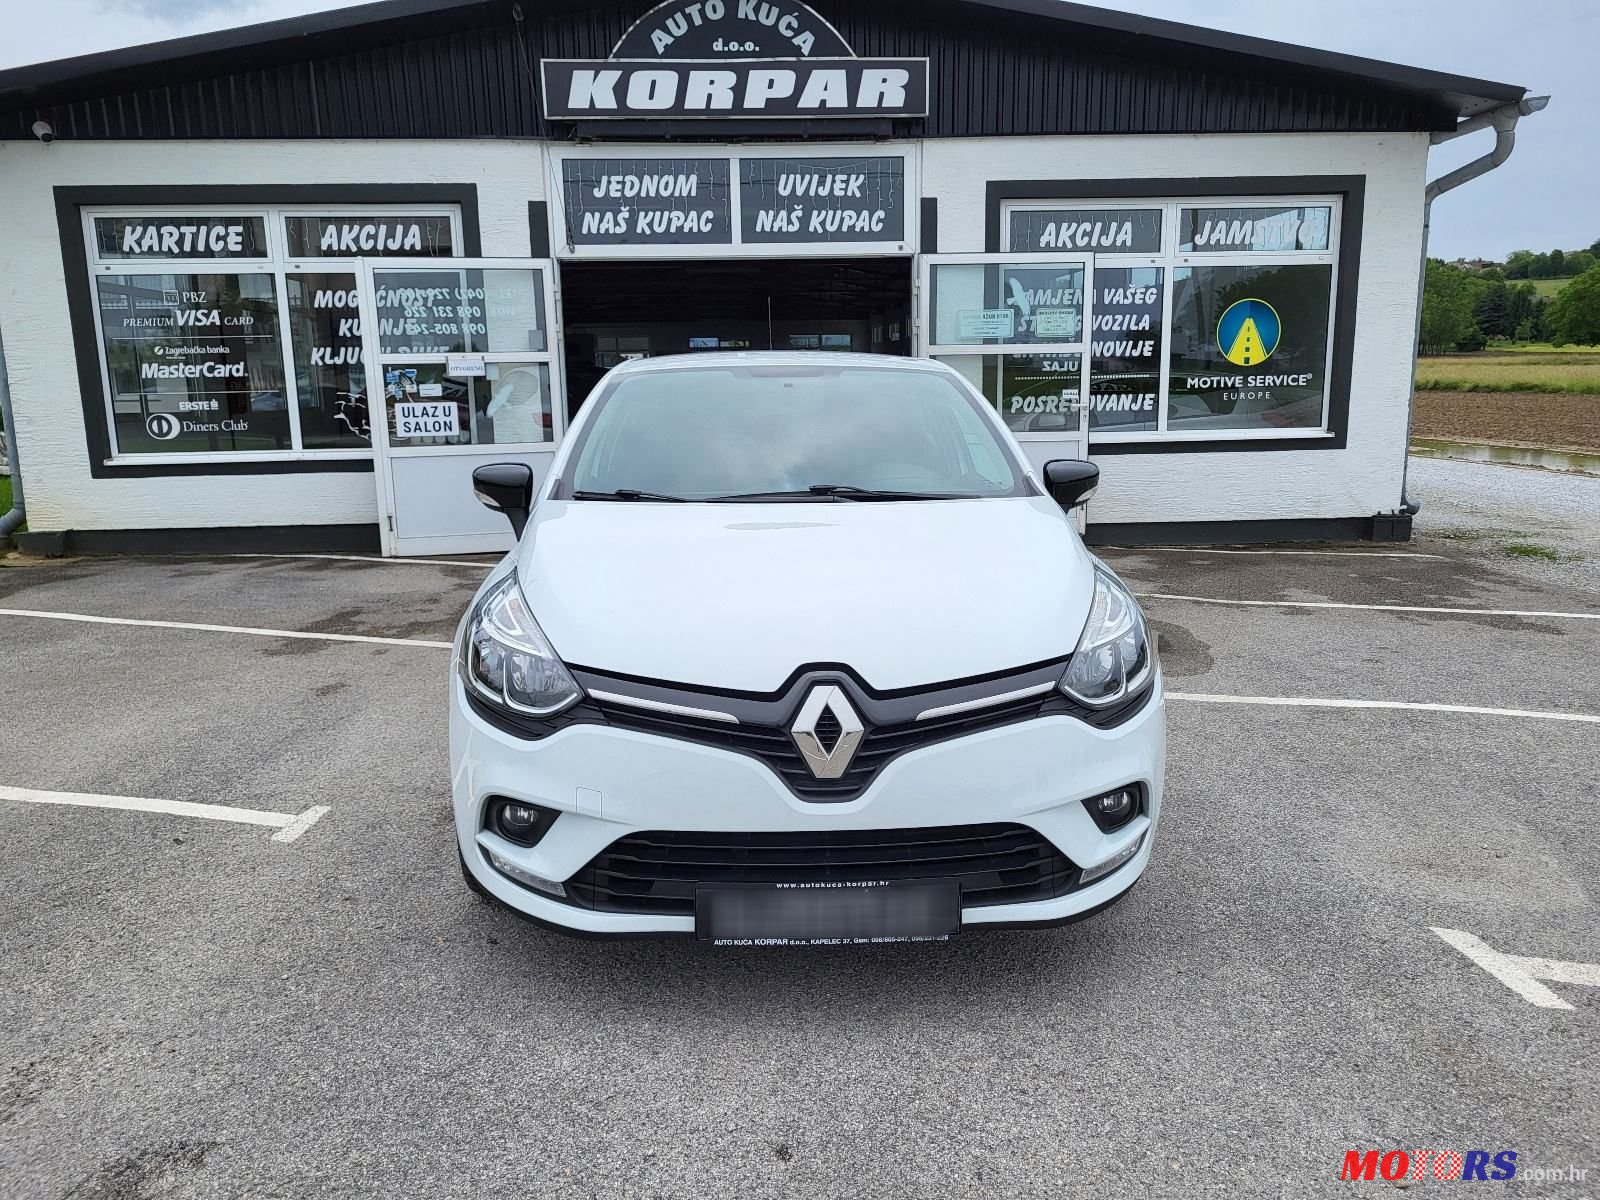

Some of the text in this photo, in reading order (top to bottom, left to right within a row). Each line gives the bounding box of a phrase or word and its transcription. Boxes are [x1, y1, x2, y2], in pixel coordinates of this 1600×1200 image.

[650, 0, 816, 57] AUTO KUĆA
[712, 38, 760, 52] d.o.o.
[567, 68, 910, 110] KORPAR
[593, 173, 698, 198] JEDNOM
[777, 173, 865, 198] UVIJEK
[581, 206, 714, 236] NAŠ KUPAC
[755, 205, 886, 233] NAŠ KUPAC
[122, 224, 244, 254] KARTICE
[320, 223, 422, 252] AKCIJA
[1038, 221, 1133, 249] AKCIJA
[181, 291, 208, 304] PBZ
[1103, 283, 1158, 305] VAŠEG
[123, 309, 254, 327] PREMIUM VISA CARD
[338, 317, 417, 337] KUNJE
[1093, 313, 1150, 332] VOZILA
[164, 345, 230, 356] Zagrebačka banka
[1092, 340, 1155, 358] NOVIJE
[1186, 375, 1244, 389] MOTIVE
[1223, 391, 1271, 401] EUROPE
[179, 401, 210, 411] ERSTE
[401, 405, 451, 418] ULAZ U
[182, 420, 219, 432] Diners
[403, 420, 453, 433] SALON
[754, 938, 788, 946] KORPAR
